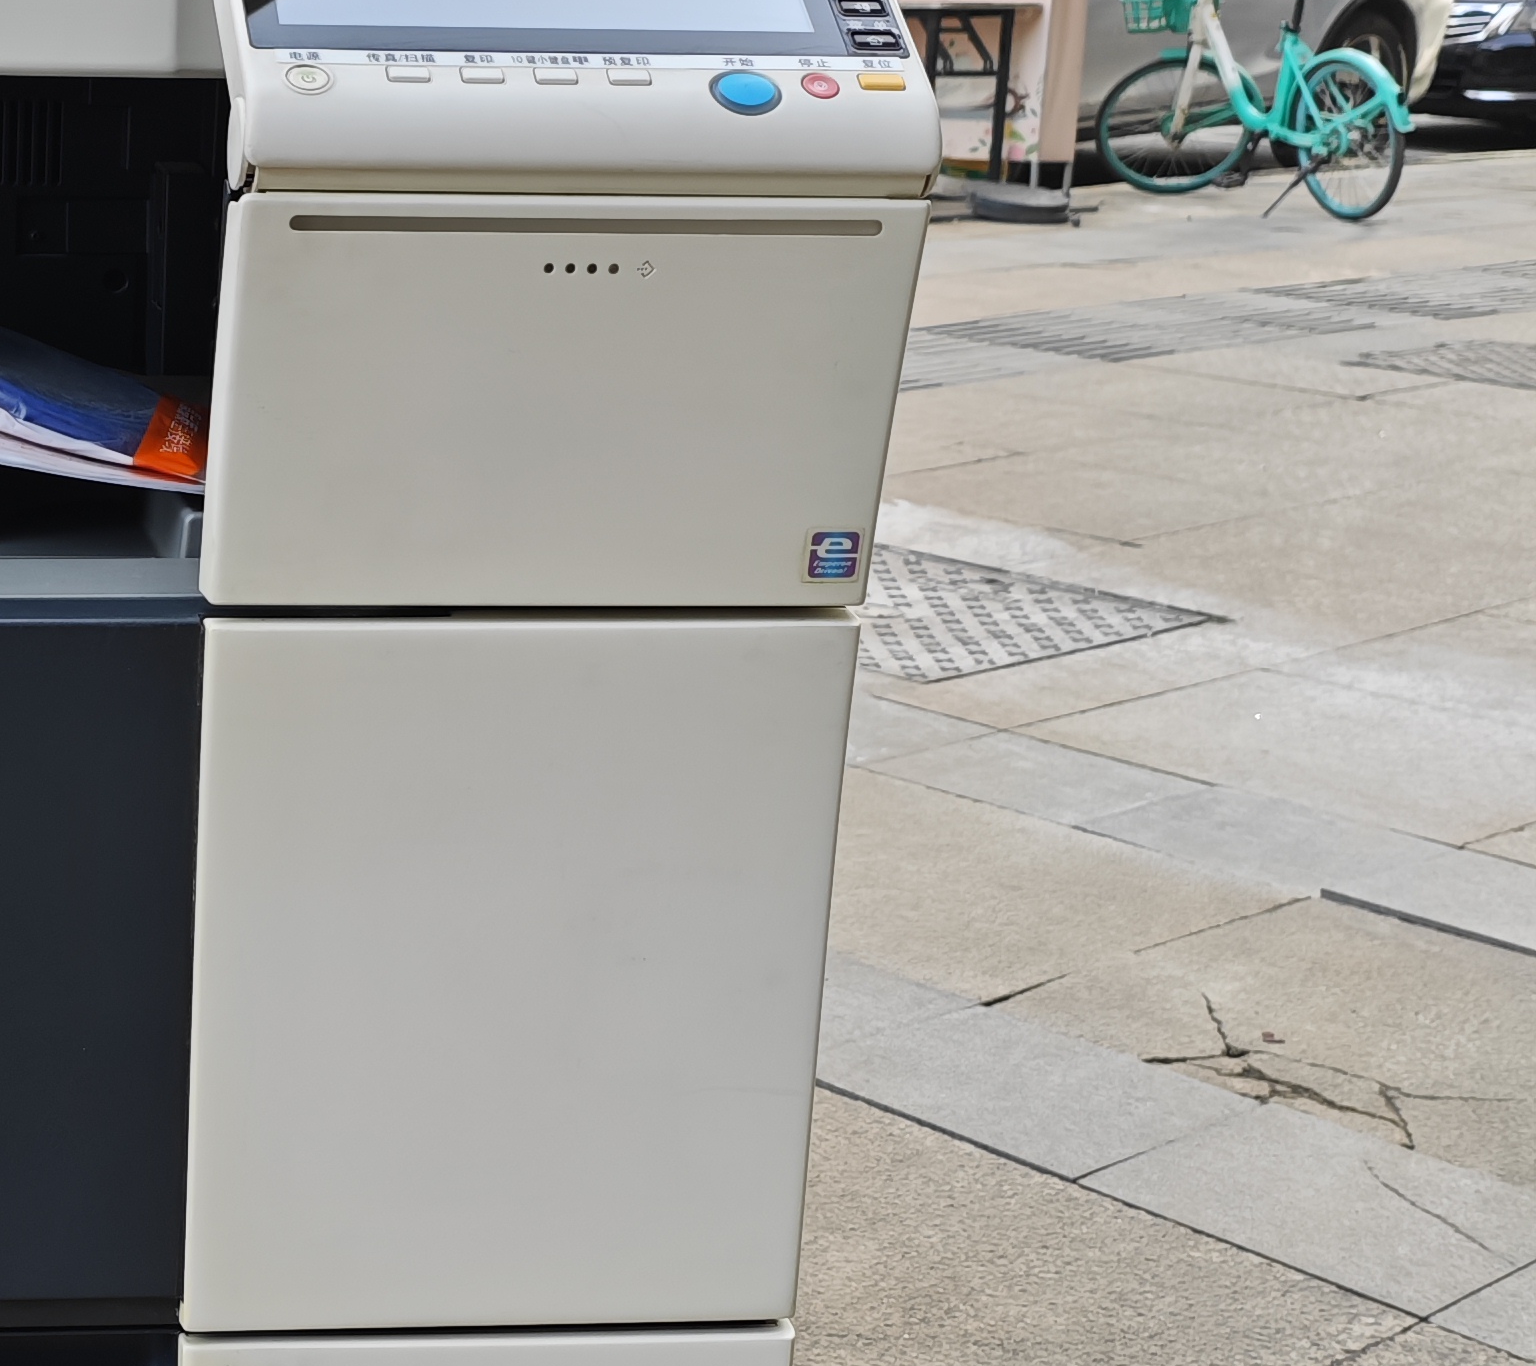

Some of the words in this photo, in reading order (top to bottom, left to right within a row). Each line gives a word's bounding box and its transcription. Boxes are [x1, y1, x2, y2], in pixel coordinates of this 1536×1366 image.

[289, 51, 322, 61] 电源
[365, 52, 437, 63] 传真/扫描
[463, 54, 495, 64] 复印
[722, 57, 755, 67] 开始
[798, 58, 832, 69] 停止
[861, 59, 893, 69] 复位
